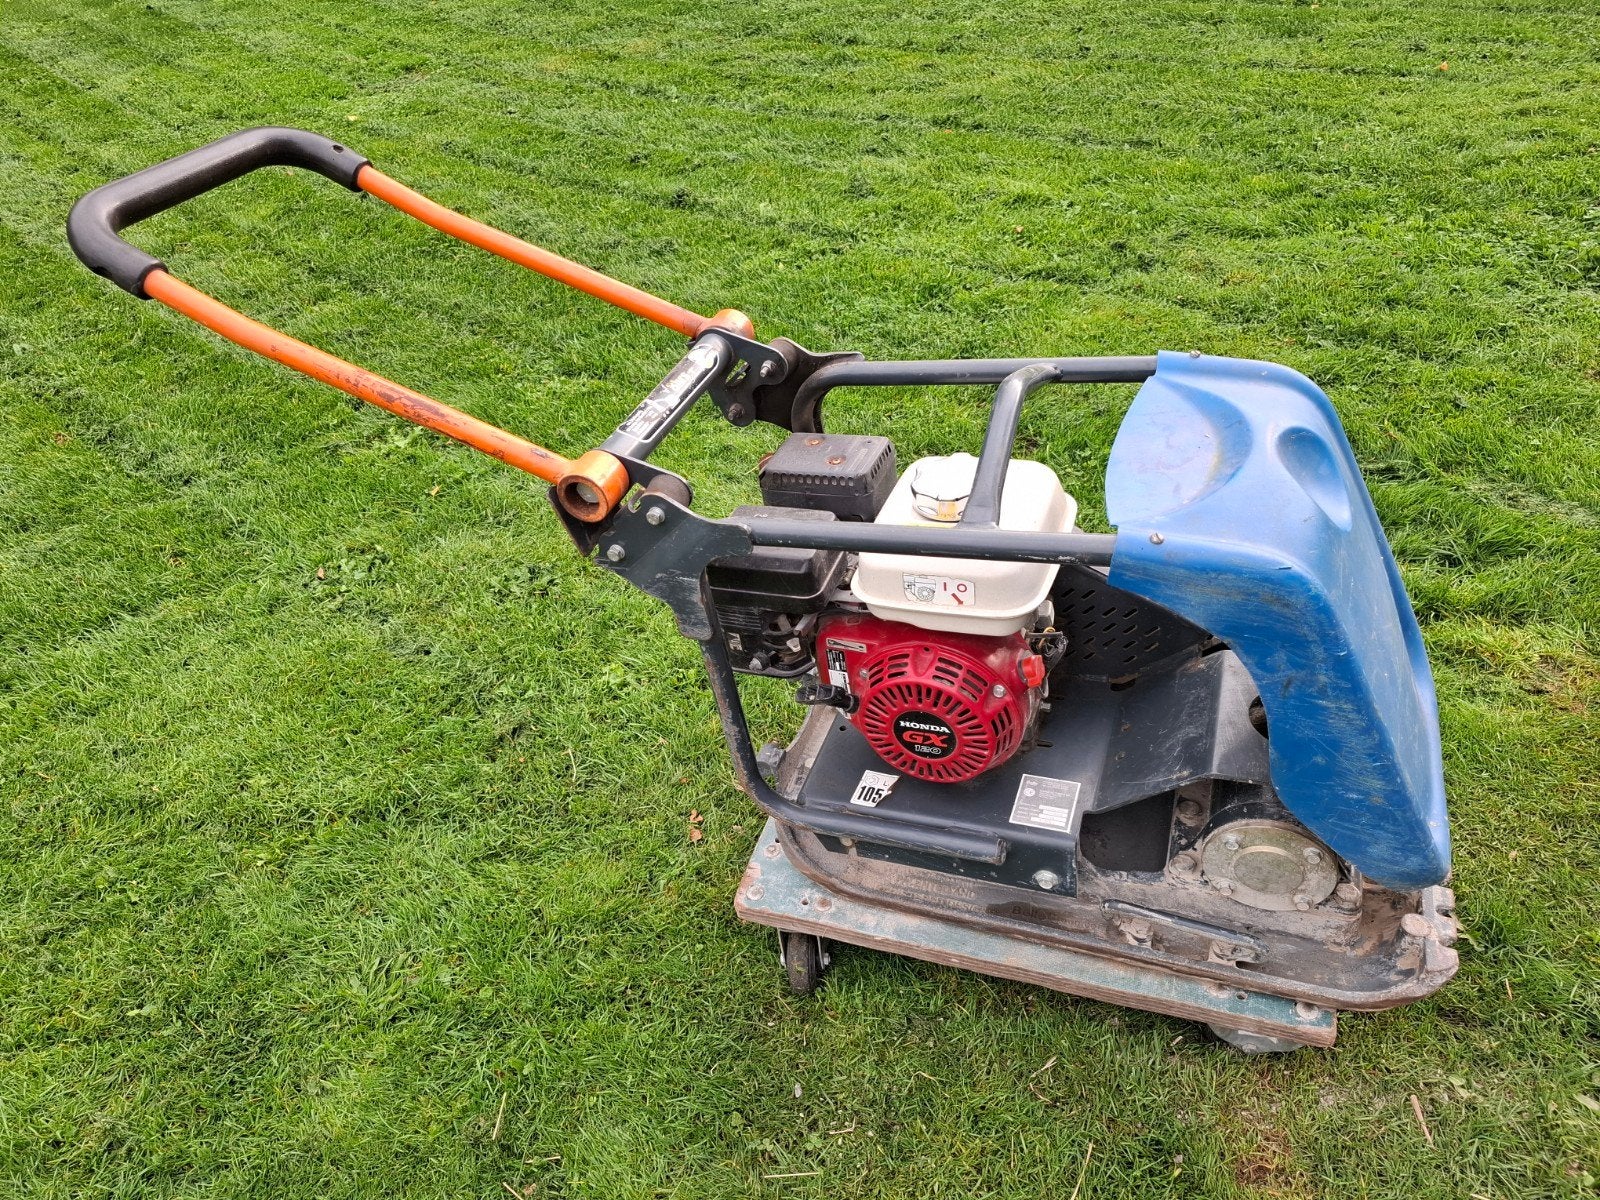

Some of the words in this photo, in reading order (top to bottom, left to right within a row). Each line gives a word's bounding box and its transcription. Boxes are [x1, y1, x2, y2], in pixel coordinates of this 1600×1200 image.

[899, 720, 951, 734] HONDA
[902, 730, 949, 748] GX
[914, 744, 942, 755] 120
[857, 785, 885, 804] 105
